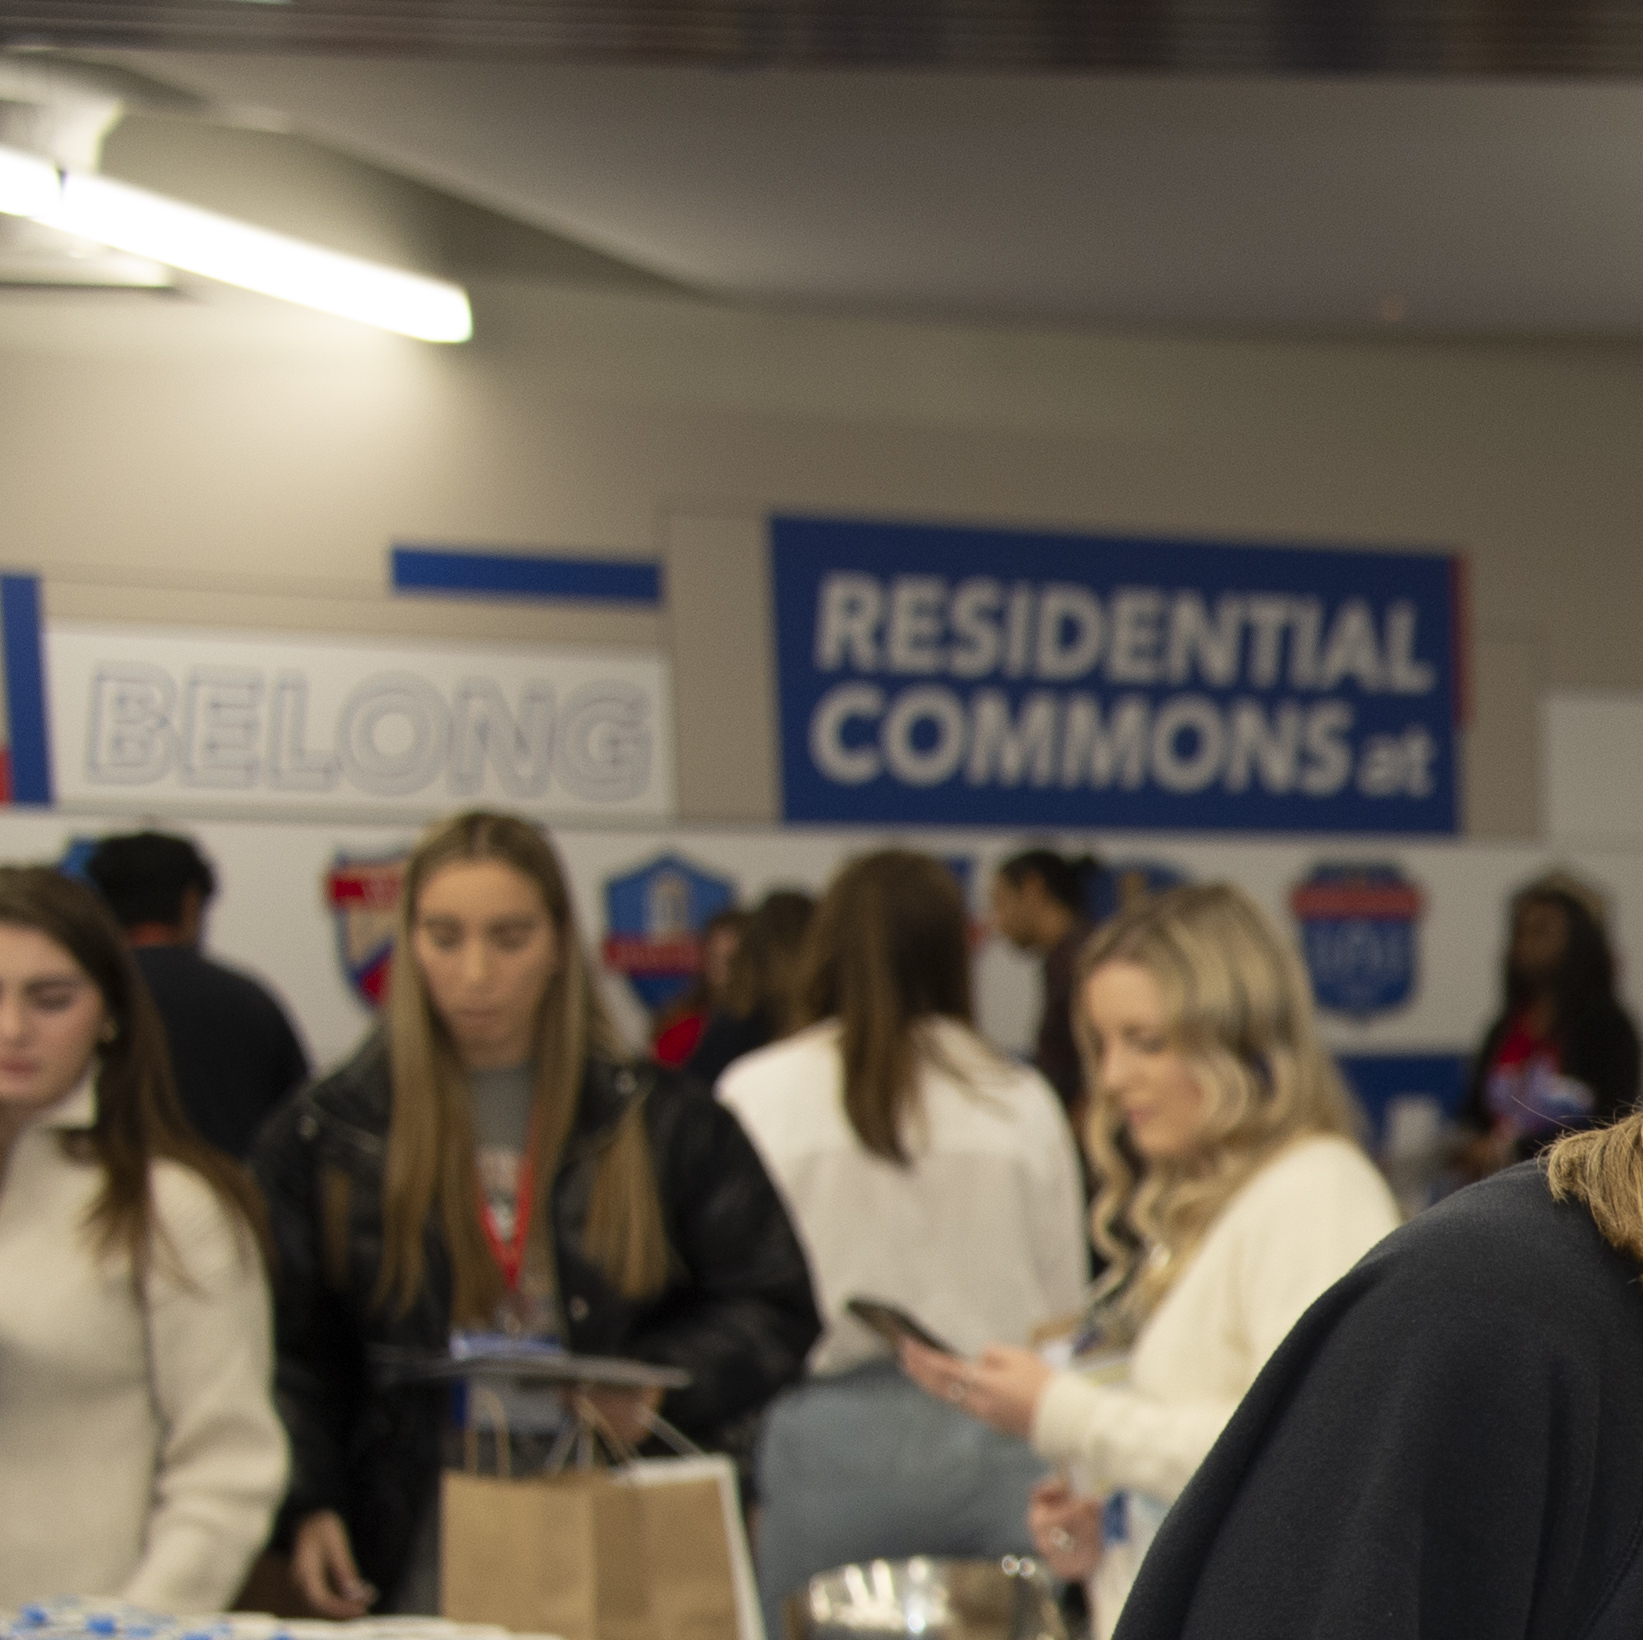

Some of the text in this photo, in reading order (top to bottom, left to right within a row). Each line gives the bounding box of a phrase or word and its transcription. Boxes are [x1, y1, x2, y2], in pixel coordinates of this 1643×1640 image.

[814, 570, 1438, 694] RESIDENTIAL
[85, 660, 652, 804] BELONG
[808, 682, 1434, 800] COMMONS at
